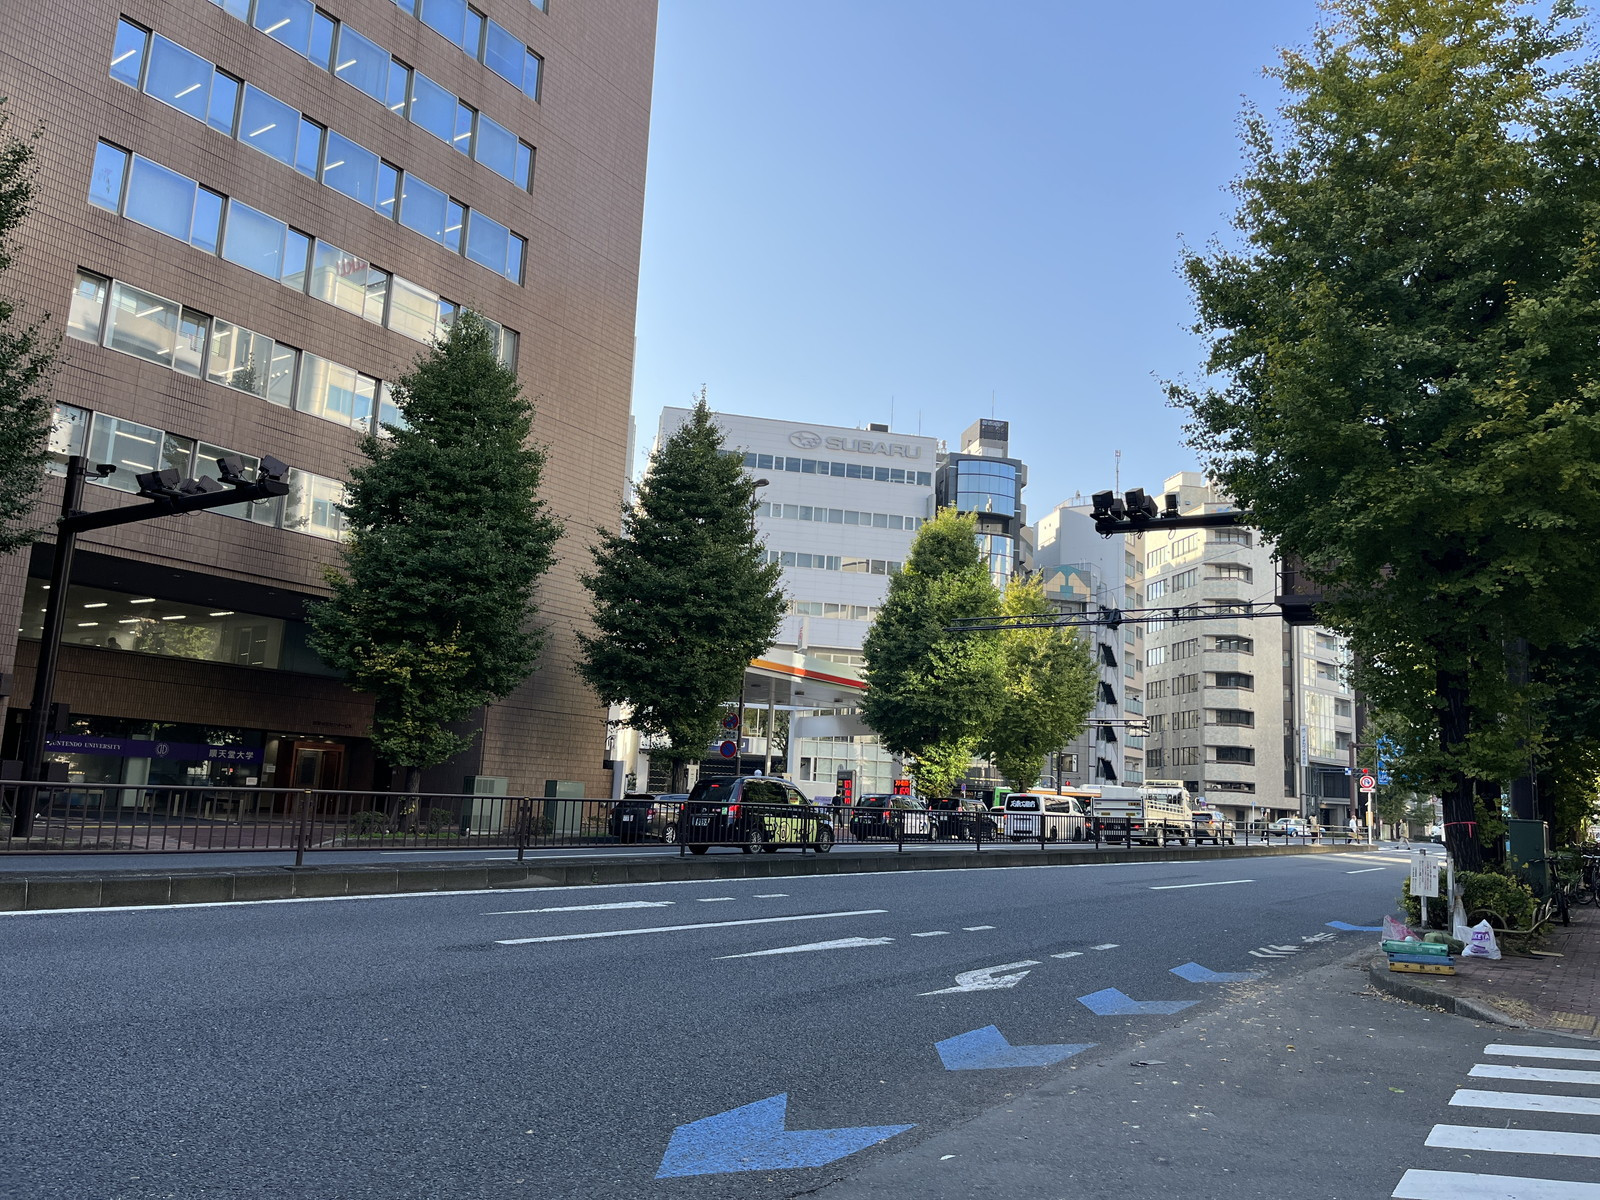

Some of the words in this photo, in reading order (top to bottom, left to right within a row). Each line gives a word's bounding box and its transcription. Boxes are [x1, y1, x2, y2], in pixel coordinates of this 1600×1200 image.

[825, 436, 922, 459] SUBARU
[84, 742, 121, 750] UNIVERSITY
[208, 749, 254, 760] 順天堂大学
